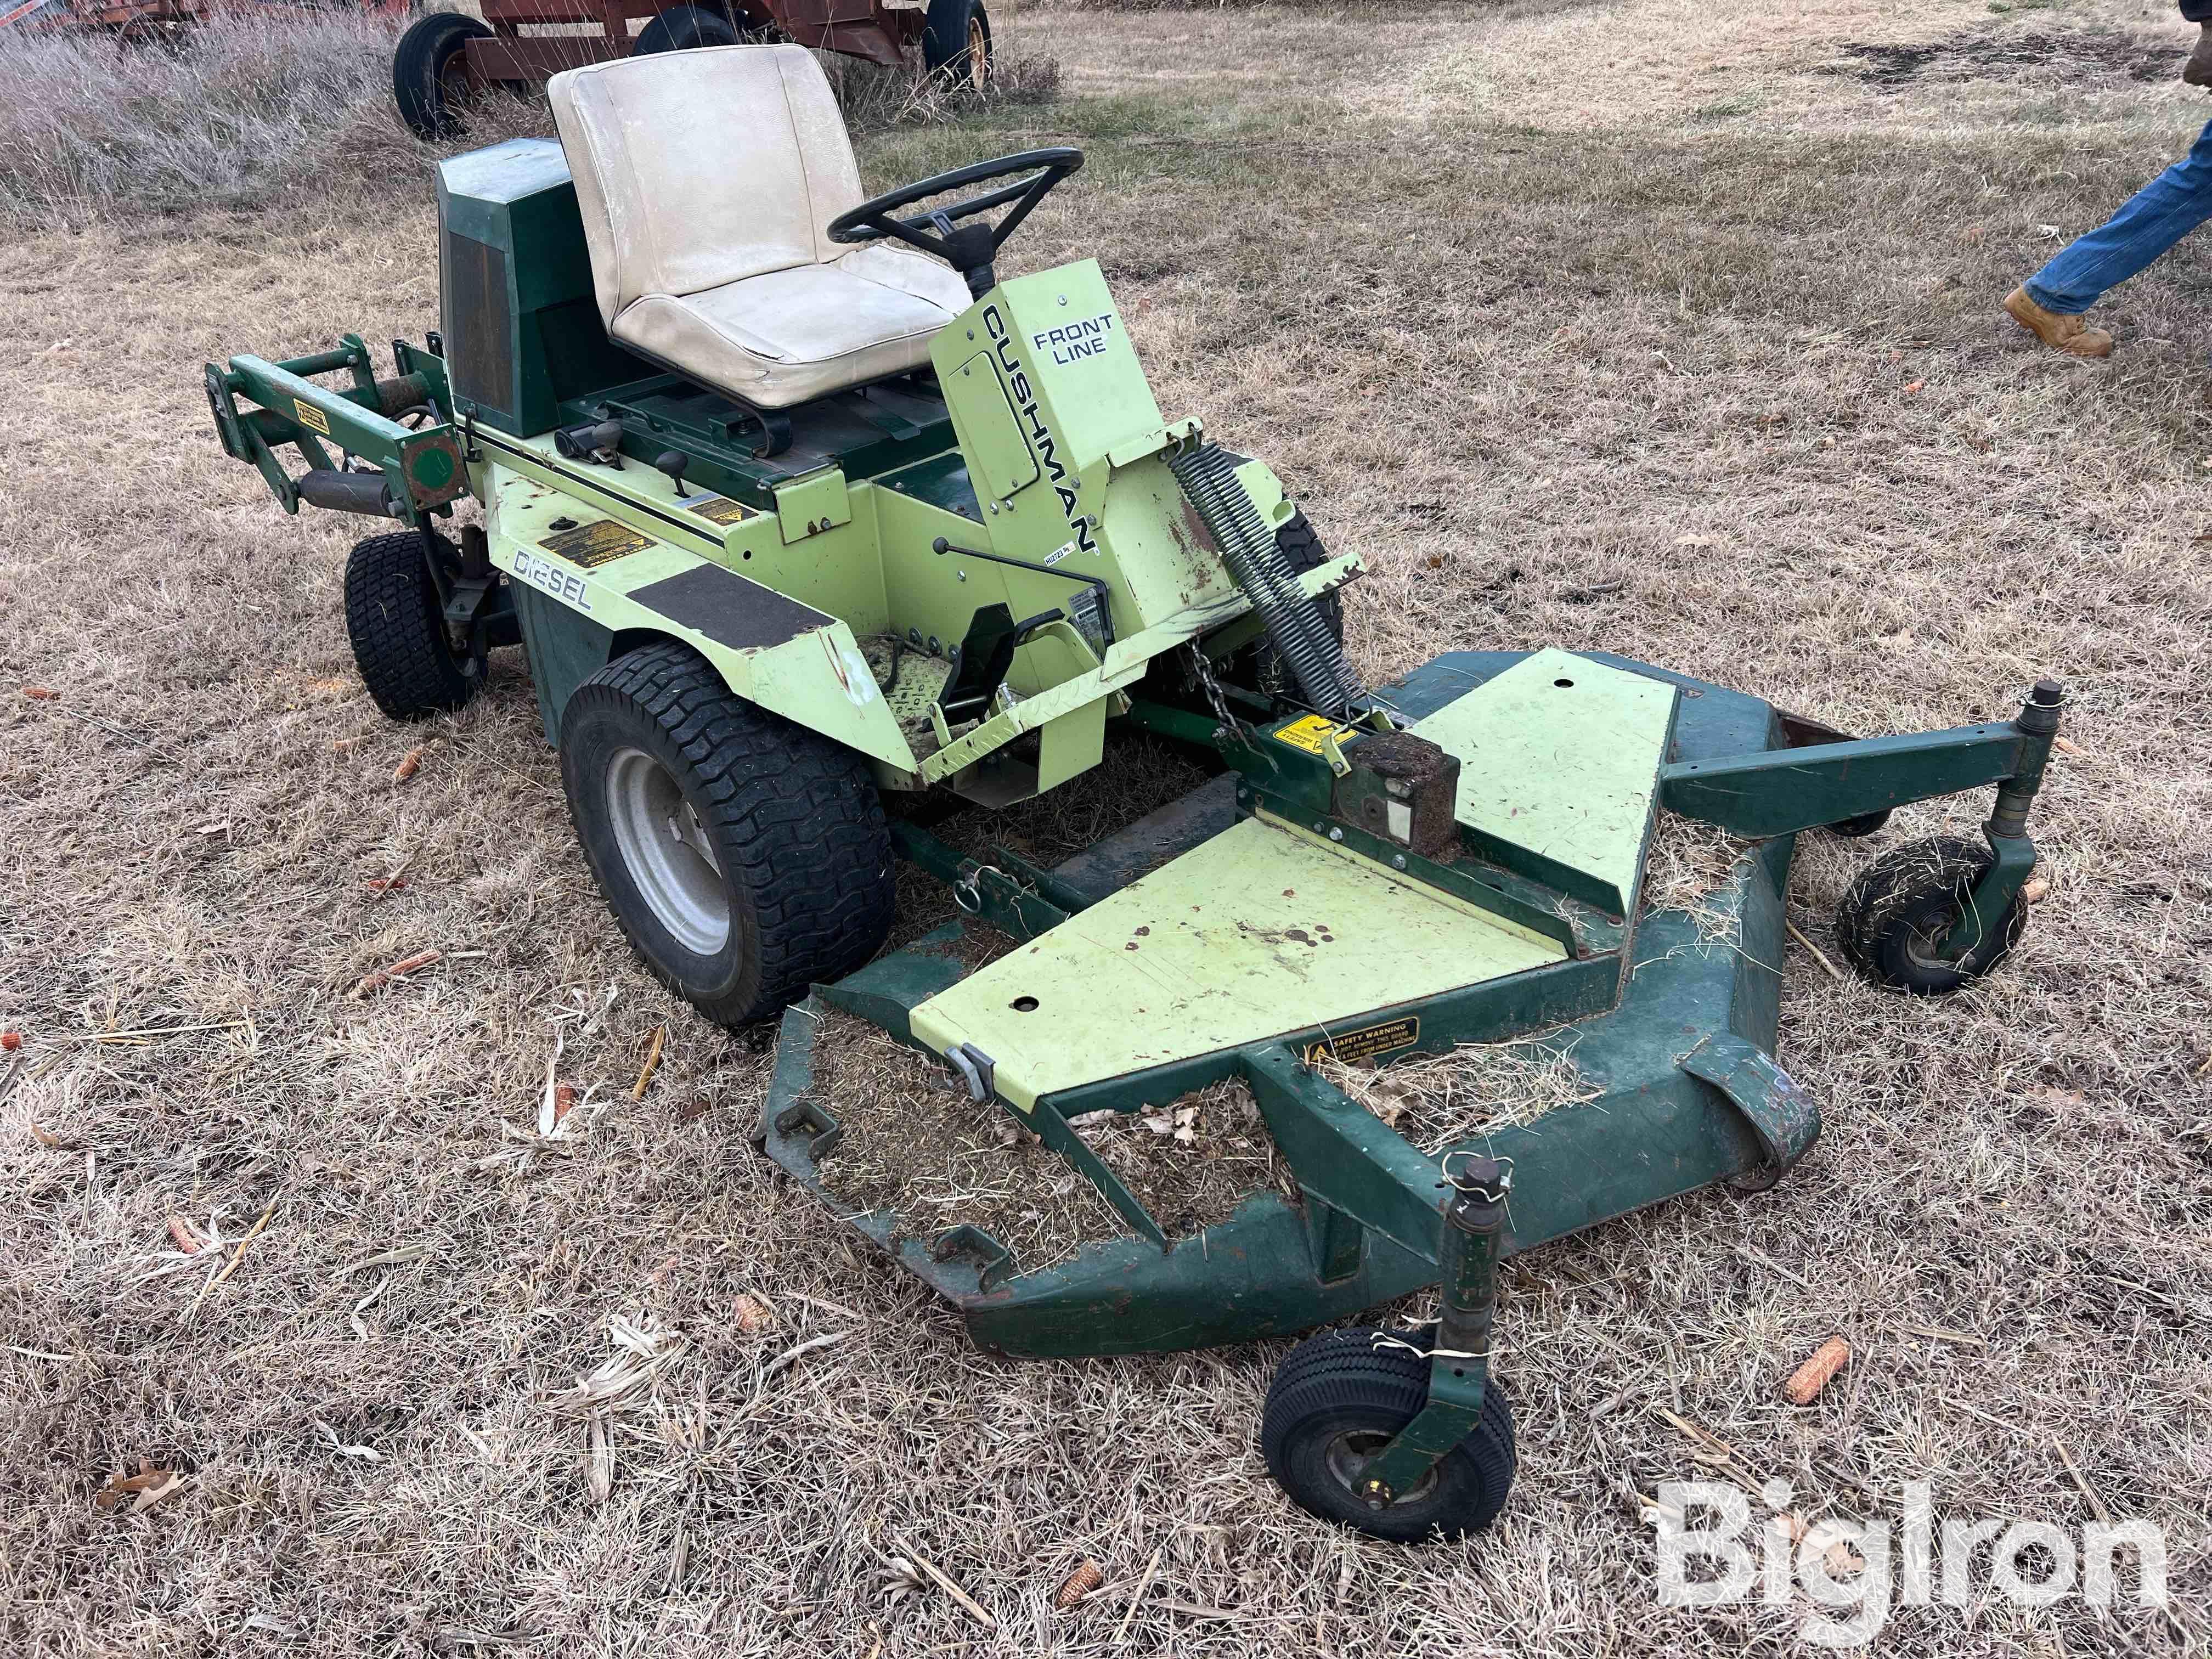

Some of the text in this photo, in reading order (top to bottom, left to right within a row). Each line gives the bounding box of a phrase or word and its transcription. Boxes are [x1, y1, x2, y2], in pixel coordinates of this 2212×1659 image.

[1033, 314, 1113, 349] FRONT
[1053, 337, 1107, 364] LINE
[983, 304, 1096, 553] CUSHMAN
[1045, 550, 1064, 565] HU2723
[514, 550, 592, 610] DIESEL
[1282, 733, 1306, 744] SAFETY
[1284, 729, 1313, 743] WARNING
[1333, 1024, 1406, 1047] SAFETY WARNING
[1375, 1041, 1392, 1050] UNDER
[1393, 1035, 1416, 1045] MACHINE
